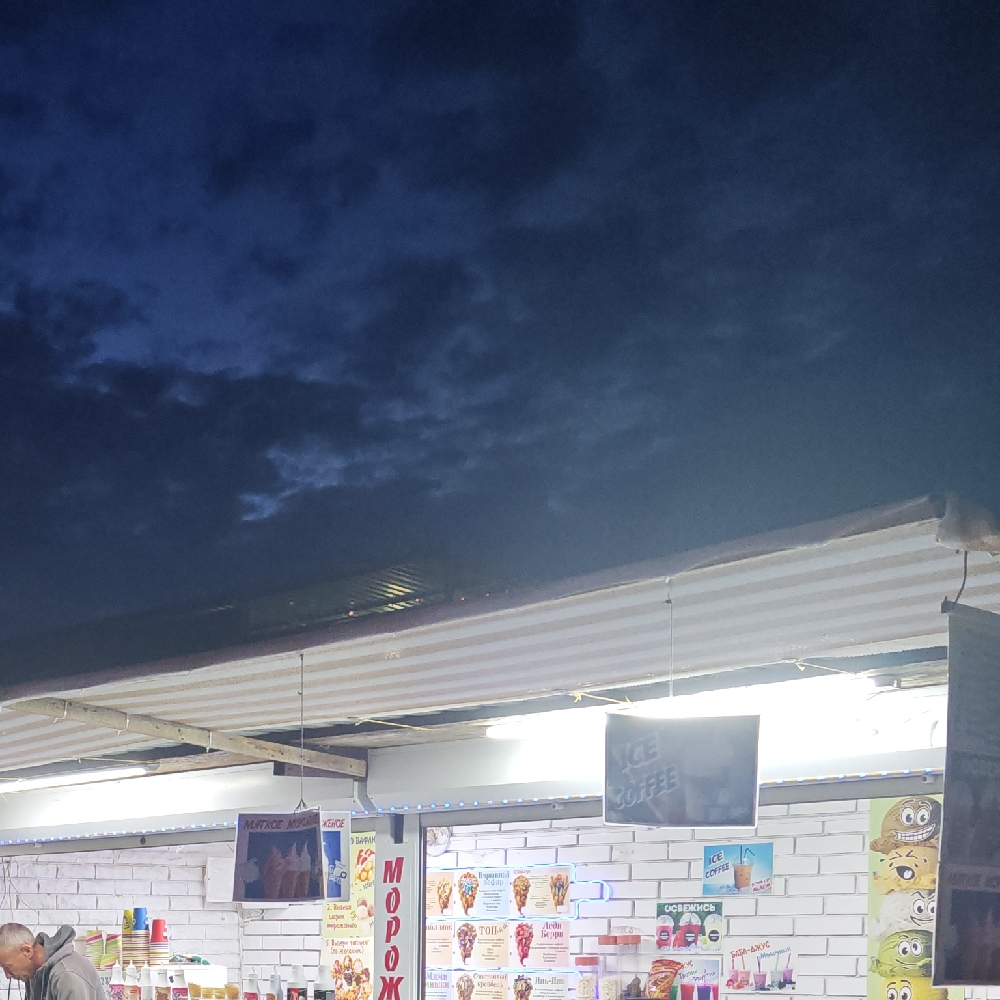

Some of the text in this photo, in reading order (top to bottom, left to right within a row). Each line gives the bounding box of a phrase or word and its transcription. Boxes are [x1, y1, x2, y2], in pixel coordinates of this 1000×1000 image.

[620, 734, 660, 768] ICE
[243, 819, 284, 830] МЯГКОЕ
[709, 852, 724, 865] ICE
[706, 862, 729, 878] COFFEE
[665, 904, 716, 912] ОСВЕЖИСЬ
[542, 921, 562, 930] Леди
[730, 941, 770, 958] БАБА-ДЖУС
